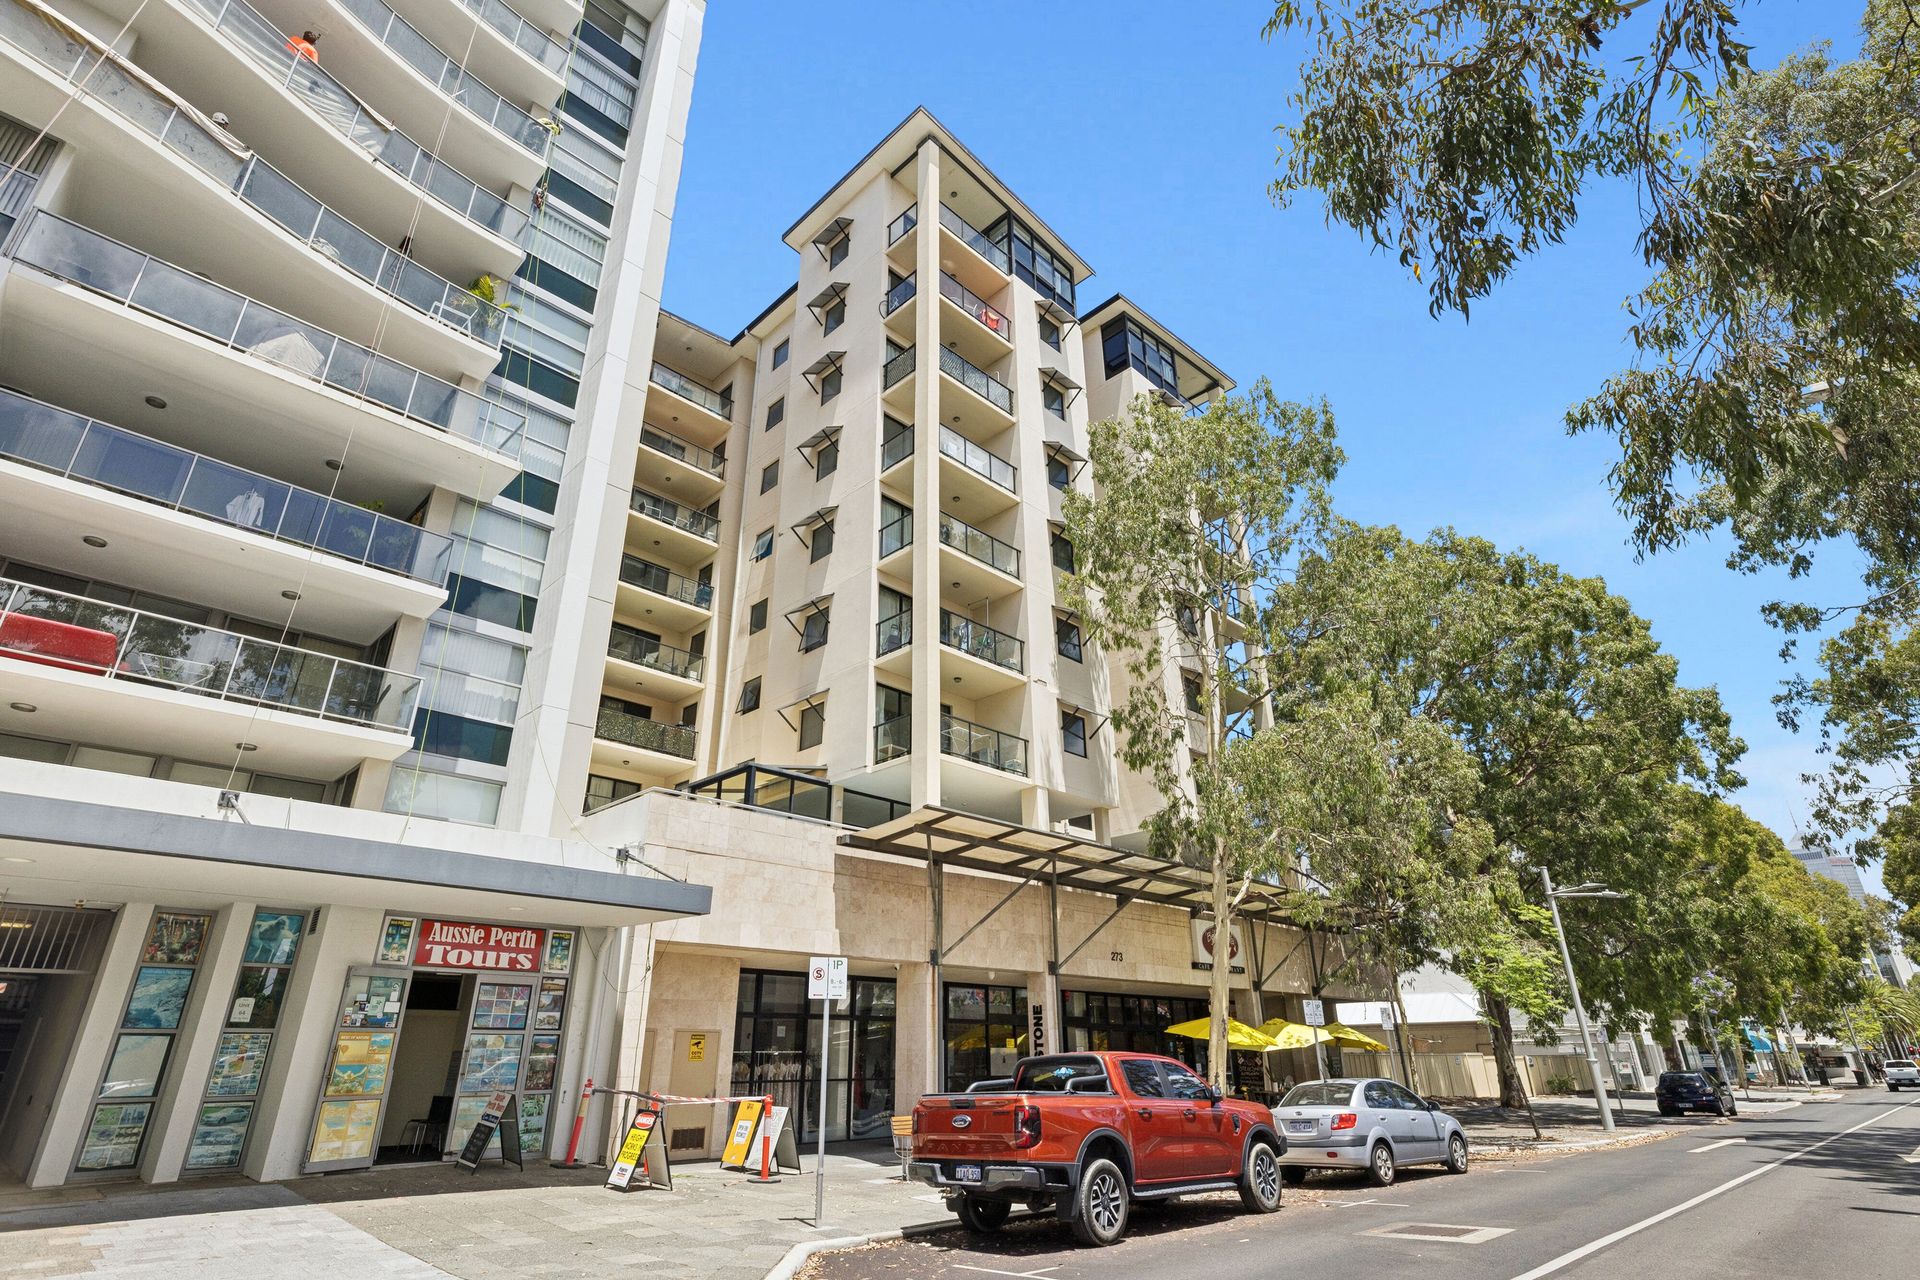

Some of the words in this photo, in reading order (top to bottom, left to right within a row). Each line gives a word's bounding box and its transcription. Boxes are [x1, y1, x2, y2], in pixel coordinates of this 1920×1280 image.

[428, 922, 485, 945] Aussie
[488, 927, 537, 949] Perth
[425, 944, 533, 970] Tours
[1111, 951, 1123, 962] 273
[815, 969, 823, 979] S
[1032, 1004, 1044, 1057] STONE
